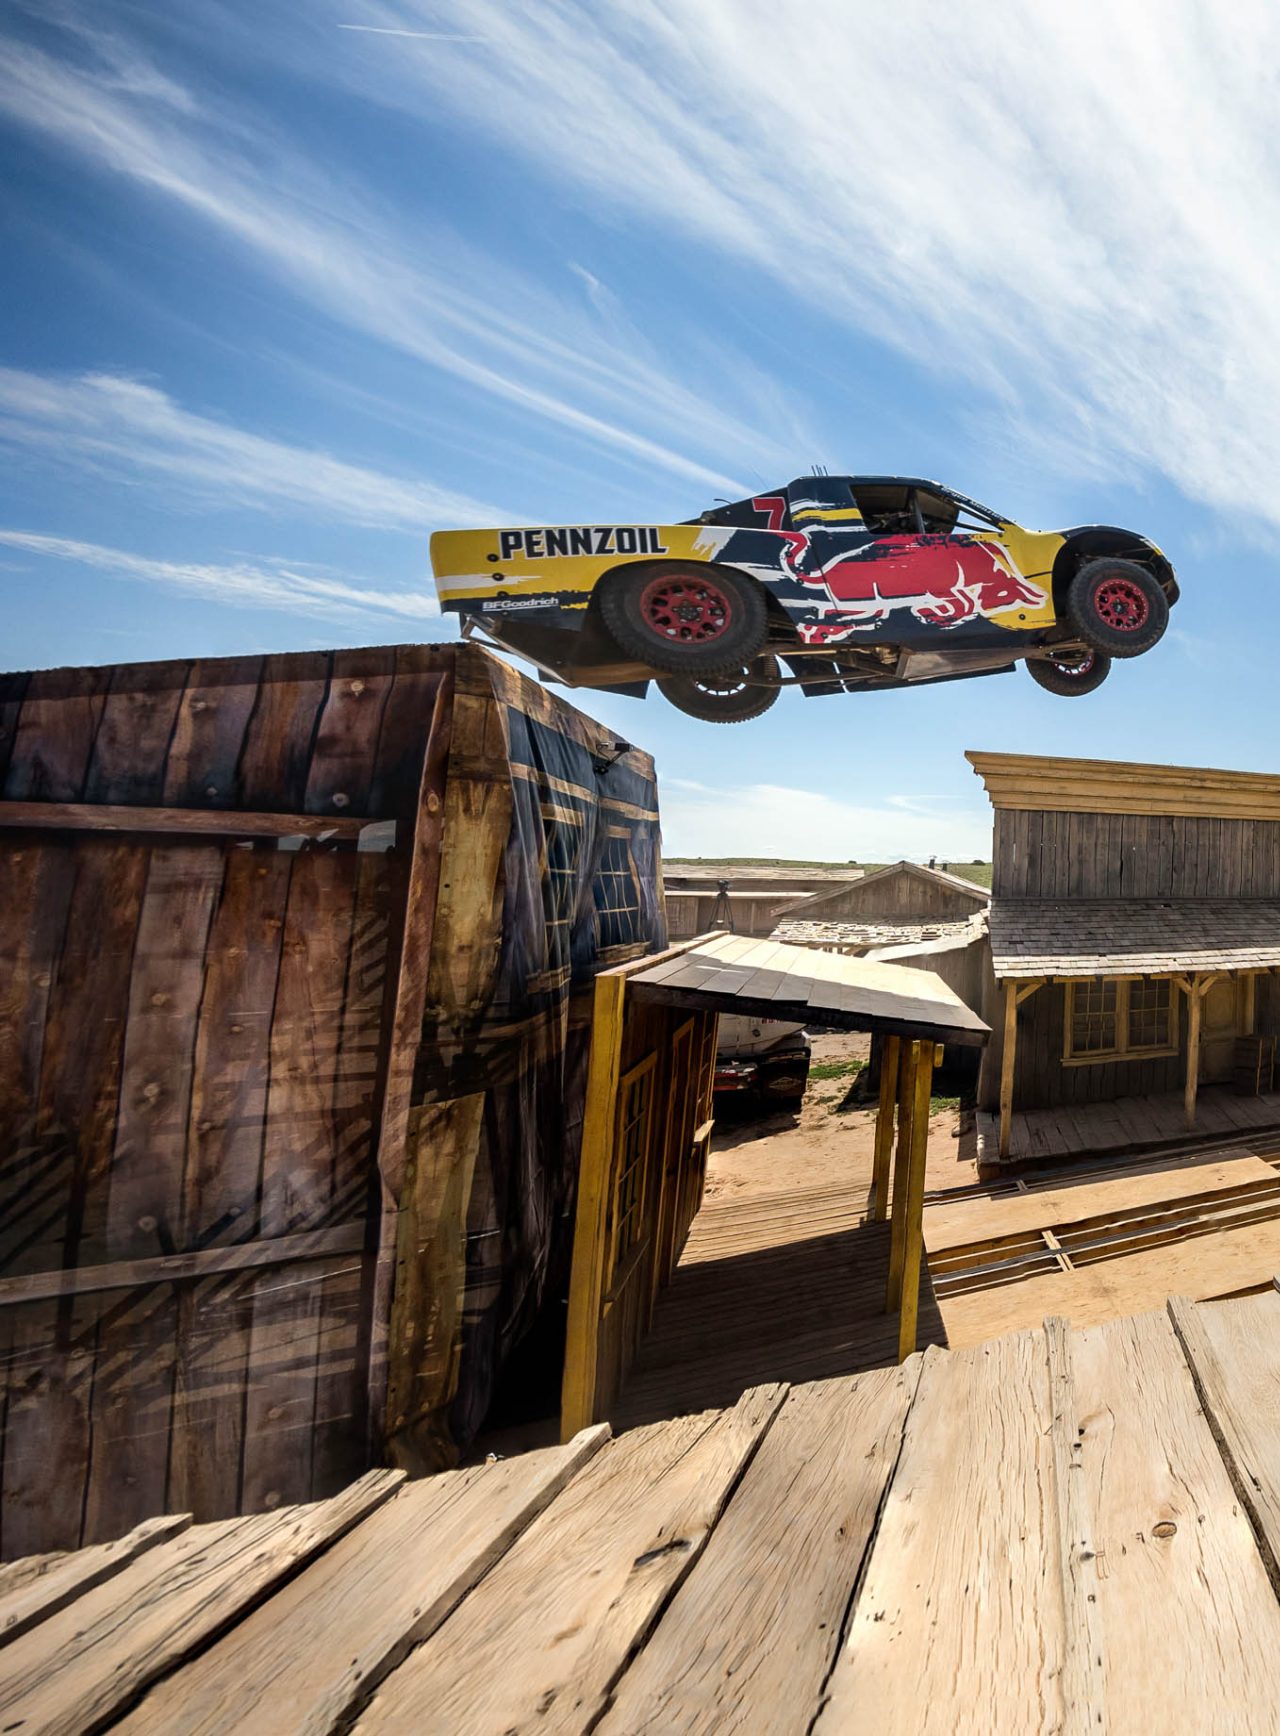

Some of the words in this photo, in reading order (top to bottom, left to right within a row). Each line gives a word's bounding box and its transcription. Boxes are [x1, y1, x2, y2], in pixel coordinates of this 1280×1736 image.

[752, 496, 787, 530] 7
[499, 527, 669, 560] PENNZOIL
[483, 597, 559, 610] BFGoodrich
